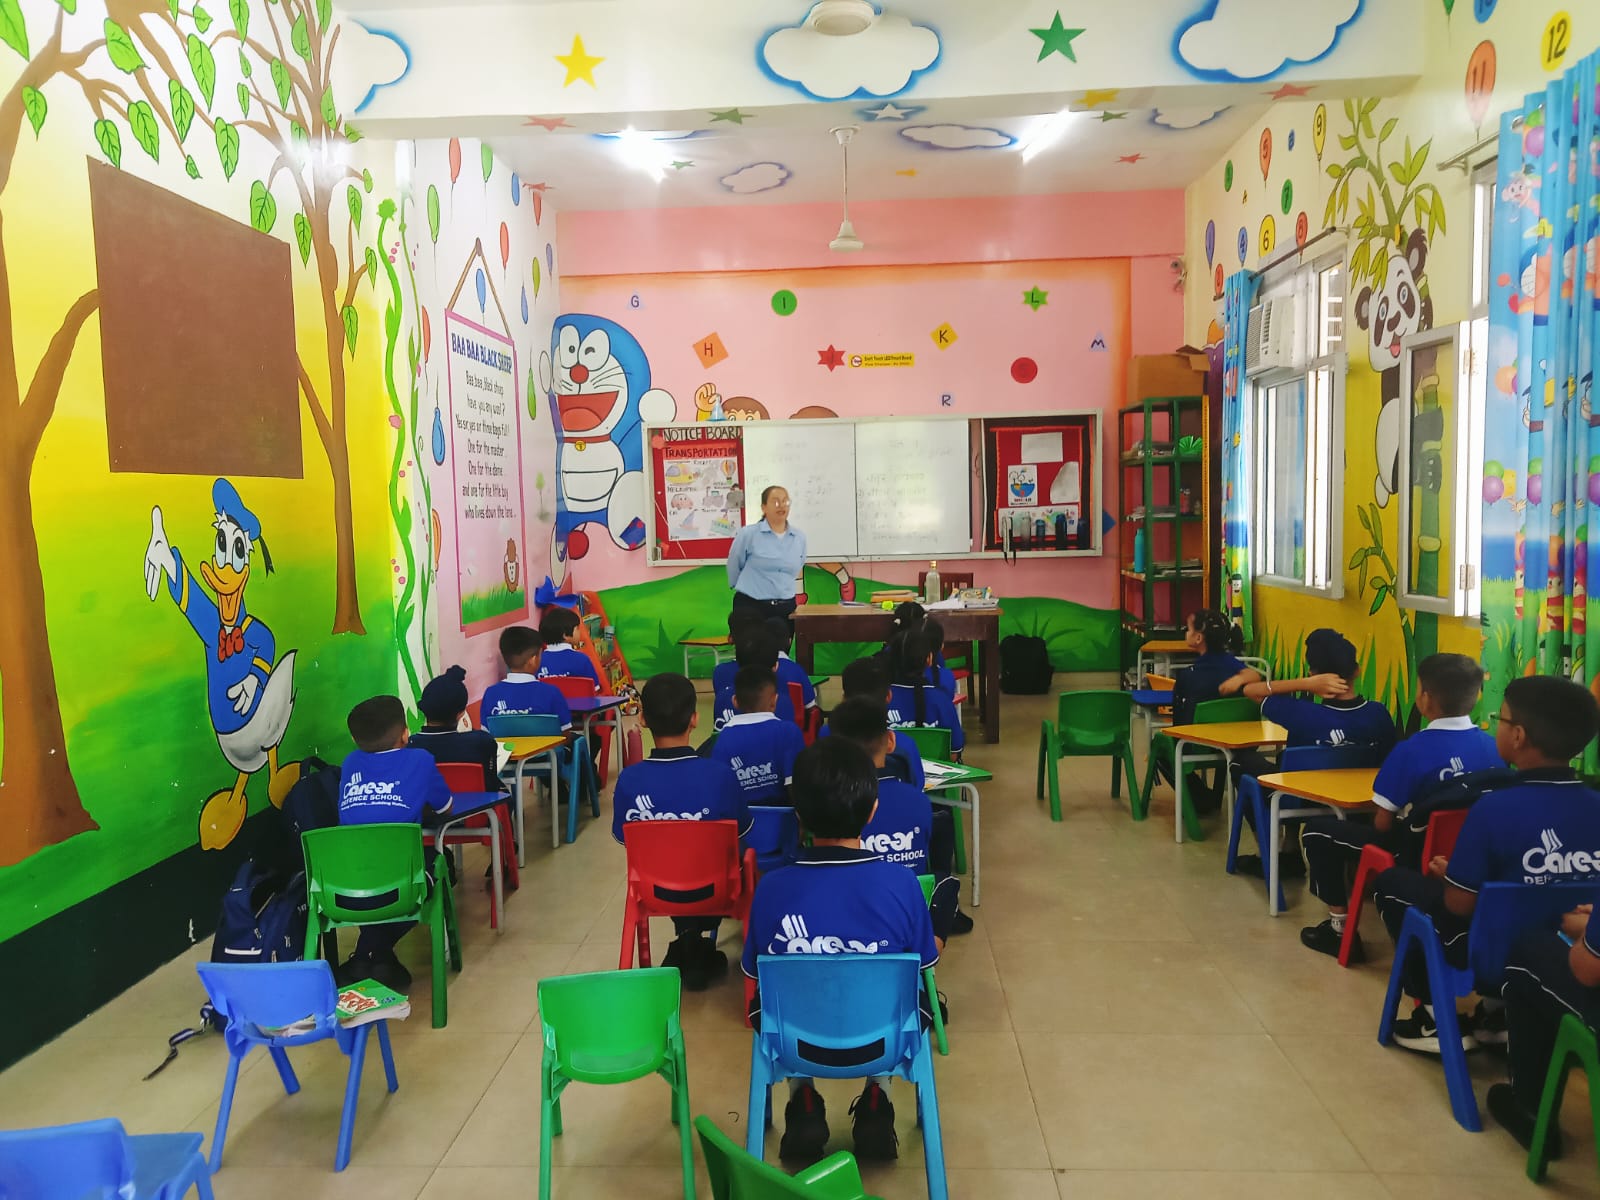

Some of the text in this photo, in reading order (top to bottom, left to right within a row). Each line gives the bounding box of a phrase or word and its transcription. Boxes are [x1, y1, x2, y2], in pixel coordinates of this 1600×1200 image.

[1547, 18, 1568, 63] 12
[1316, 114, 1322, 137] 9
[1283, 186, 1290, 208] 7
[1262, 230, 1270, 251] 6
[630, 295, 640, 308] G
[1031, 291, 1041, 304] L
[939, 329, 949, 344] K
[1090, 339, 1105, 349] M
[452, 332, 466, 356] BAA
[466, 339, 480, 362] BAA
[480, 345, 498, 369] BLACK
[703, 342, 714, 358] H
[942, 394, 951, 407] R
[663, 426, 743, 442] NOTICE BOARD
[665, 446, 738, 458] TRANSPORTATION
[369, 794, 403, 802] SCHOOL
[886, 849, 925, 863] SCHOOL
